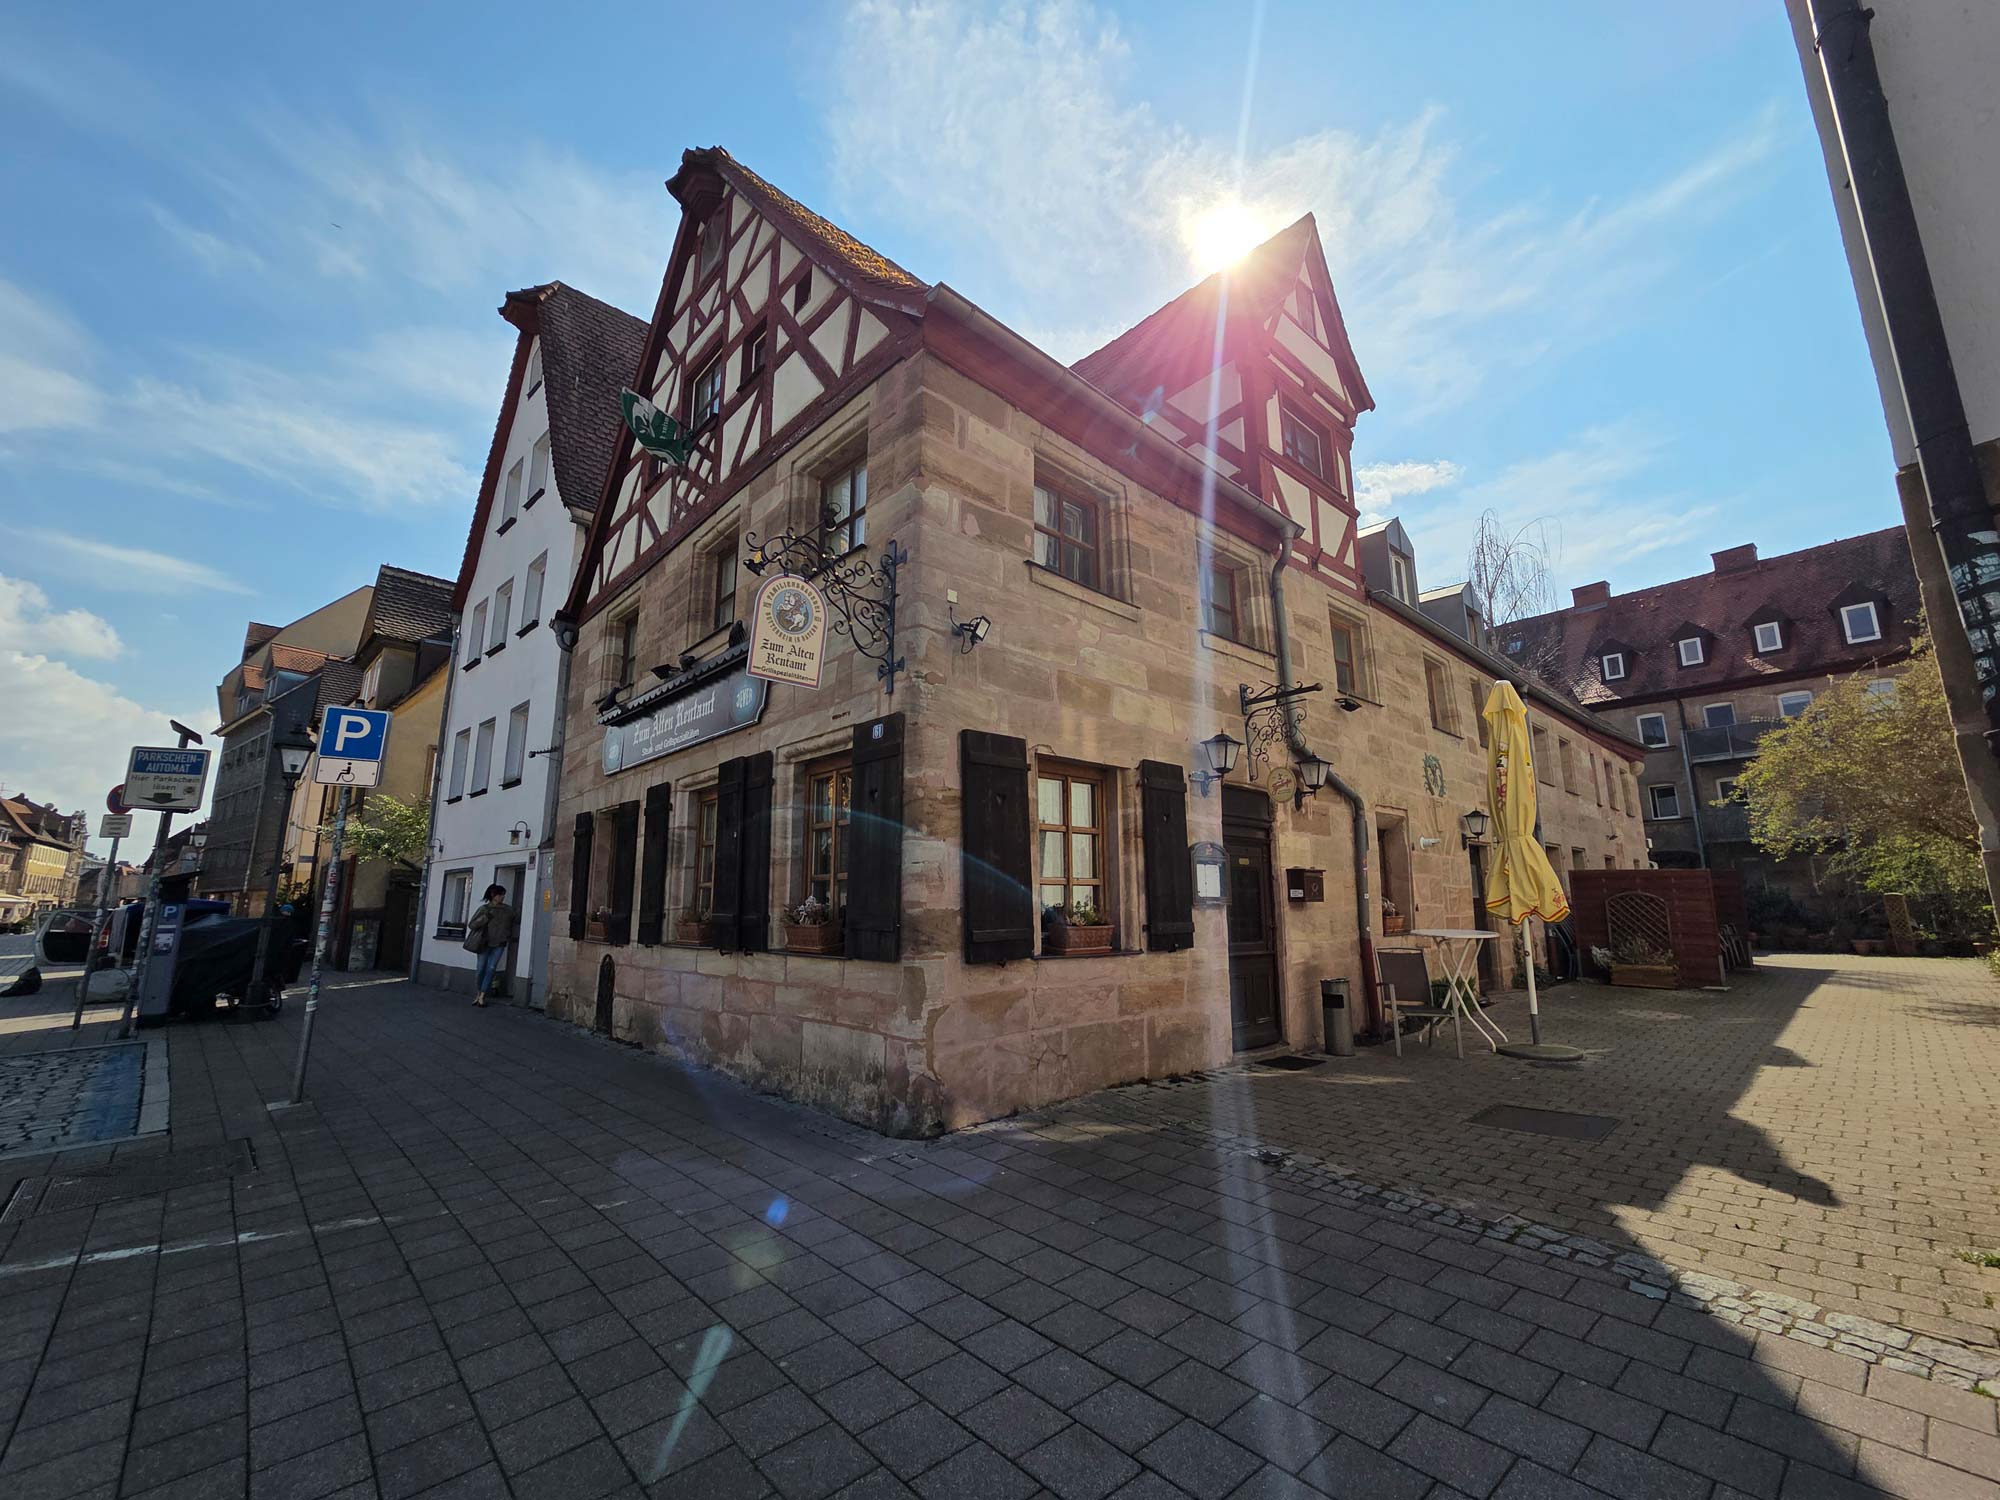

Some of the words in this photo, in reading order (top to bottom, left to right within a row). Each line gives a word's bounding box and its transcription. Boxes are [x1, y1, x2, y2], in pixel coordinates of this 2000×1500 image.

[760, 638, 784, 653] Zum
[787, 644, 815, 660] Alten
[765, 652, 807, 671] Rentamt
[761, 666, 809, 680] Grillspezialitäten
[632, 722, 650, 745] Zum
[650, 713, 673, 742] Alten
[674, 691, 716, 735] Rentamt
[334, 714, 372, 752] P
[137, 751, 202, 763] PARKSCHEIN-
[145, 762, 191, 773] AUTOMAT
[153, 775, 200, 783] Parkschein
[163, 905, 177, 918] P
